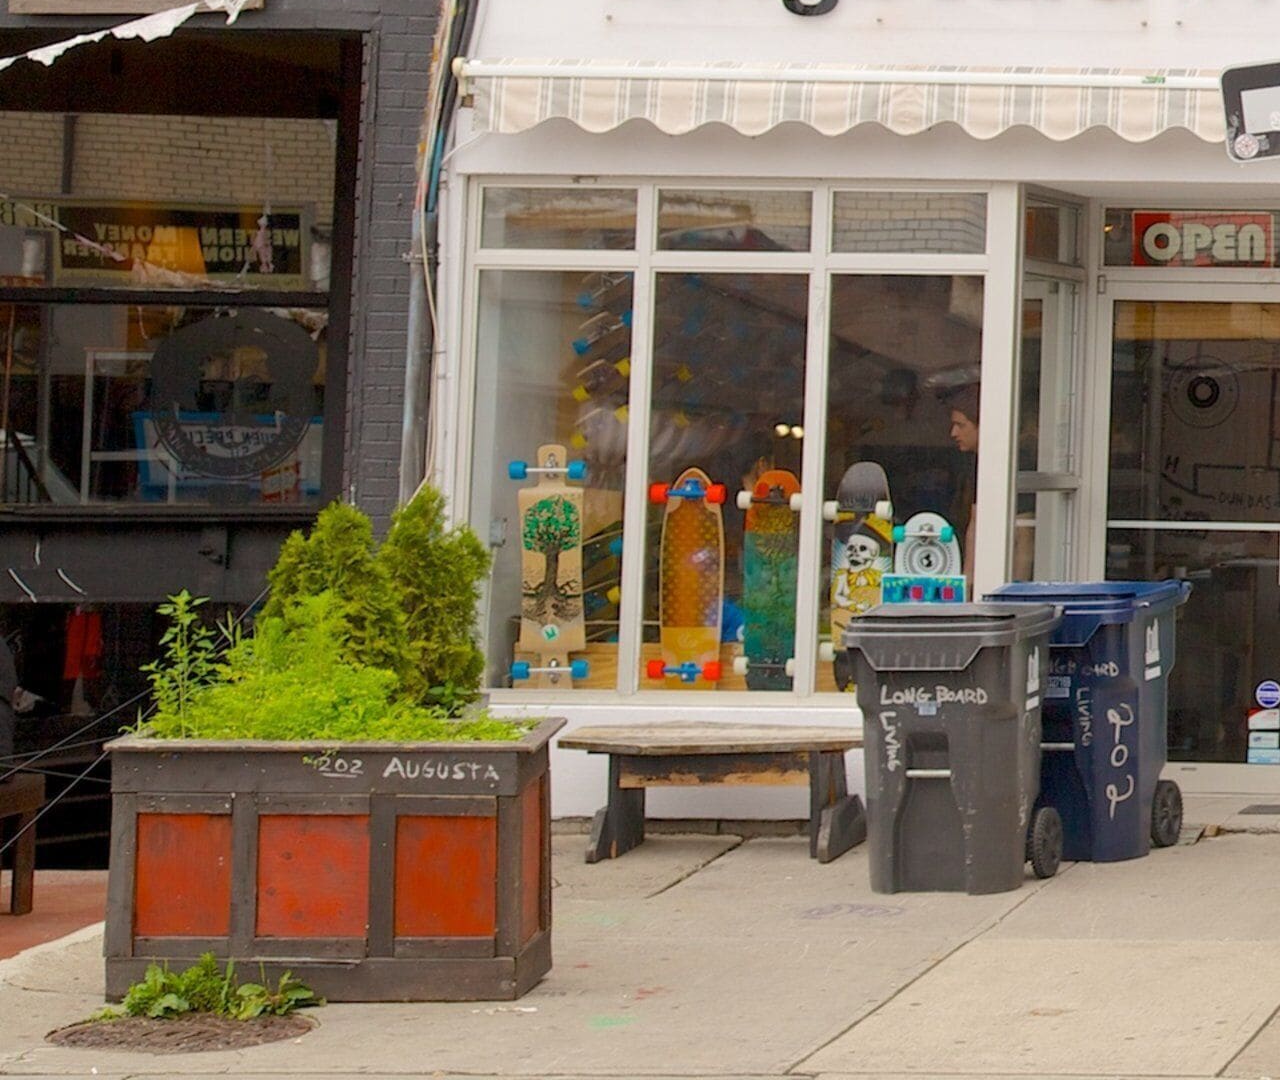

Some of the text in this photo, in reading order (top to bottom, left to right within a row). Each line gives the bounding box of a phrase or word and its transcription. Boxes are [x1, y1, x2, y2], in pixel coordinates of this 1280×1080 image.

[1143, 222, 1265, 262] OPEN
[880, 685, 988, 708] LONG BOARD
[319, 757, 500, 780] 202 AUGUSTA
